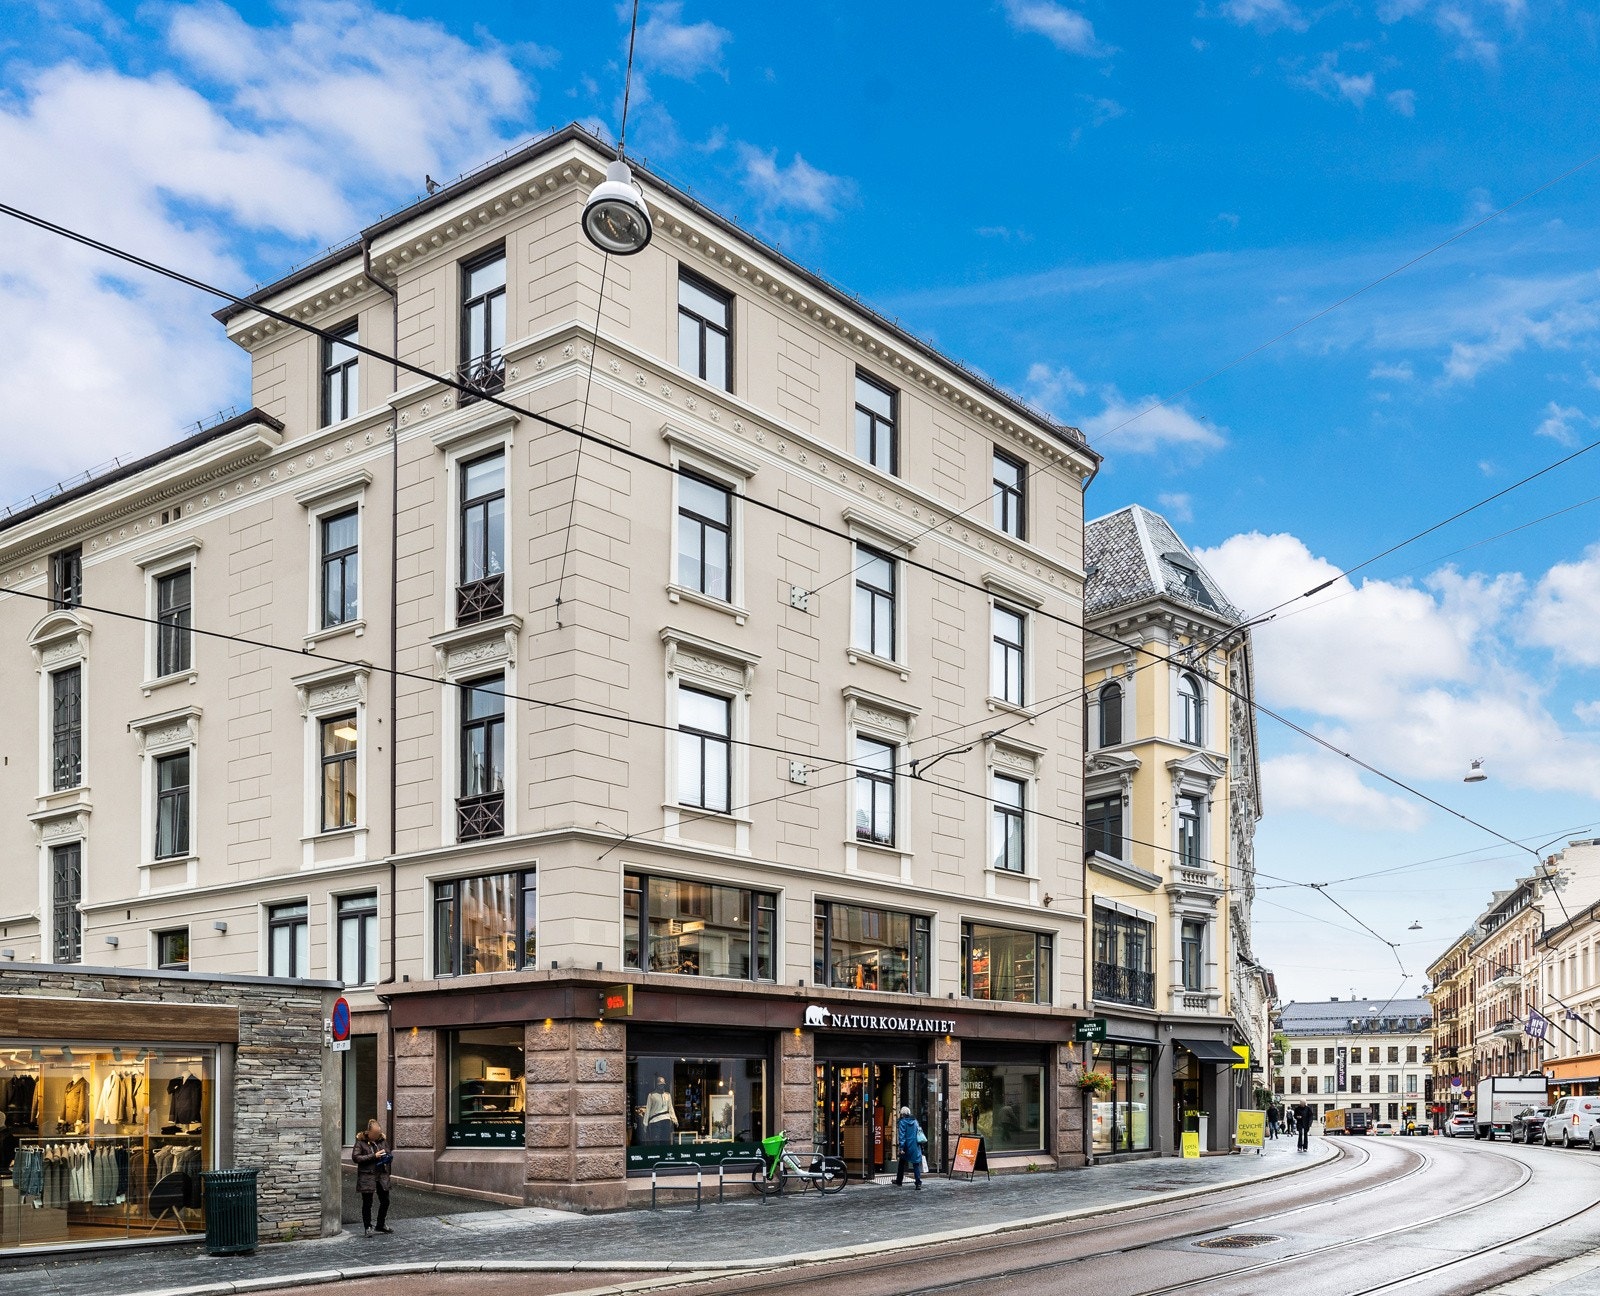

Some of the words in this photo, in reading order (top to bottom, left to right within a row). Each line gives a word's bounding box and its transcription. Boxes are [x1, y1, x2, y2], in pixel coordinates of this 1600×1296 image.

[831, 1014, 956, 1033] NATURKOMPANIET
[970, 1090, 980, 1099] HER
[1238, 1122, 1263, 1130] CEVICHE
[874, 1125, 882, 1145] SALG
[1241, 1130, 1257, 1138] POKE
